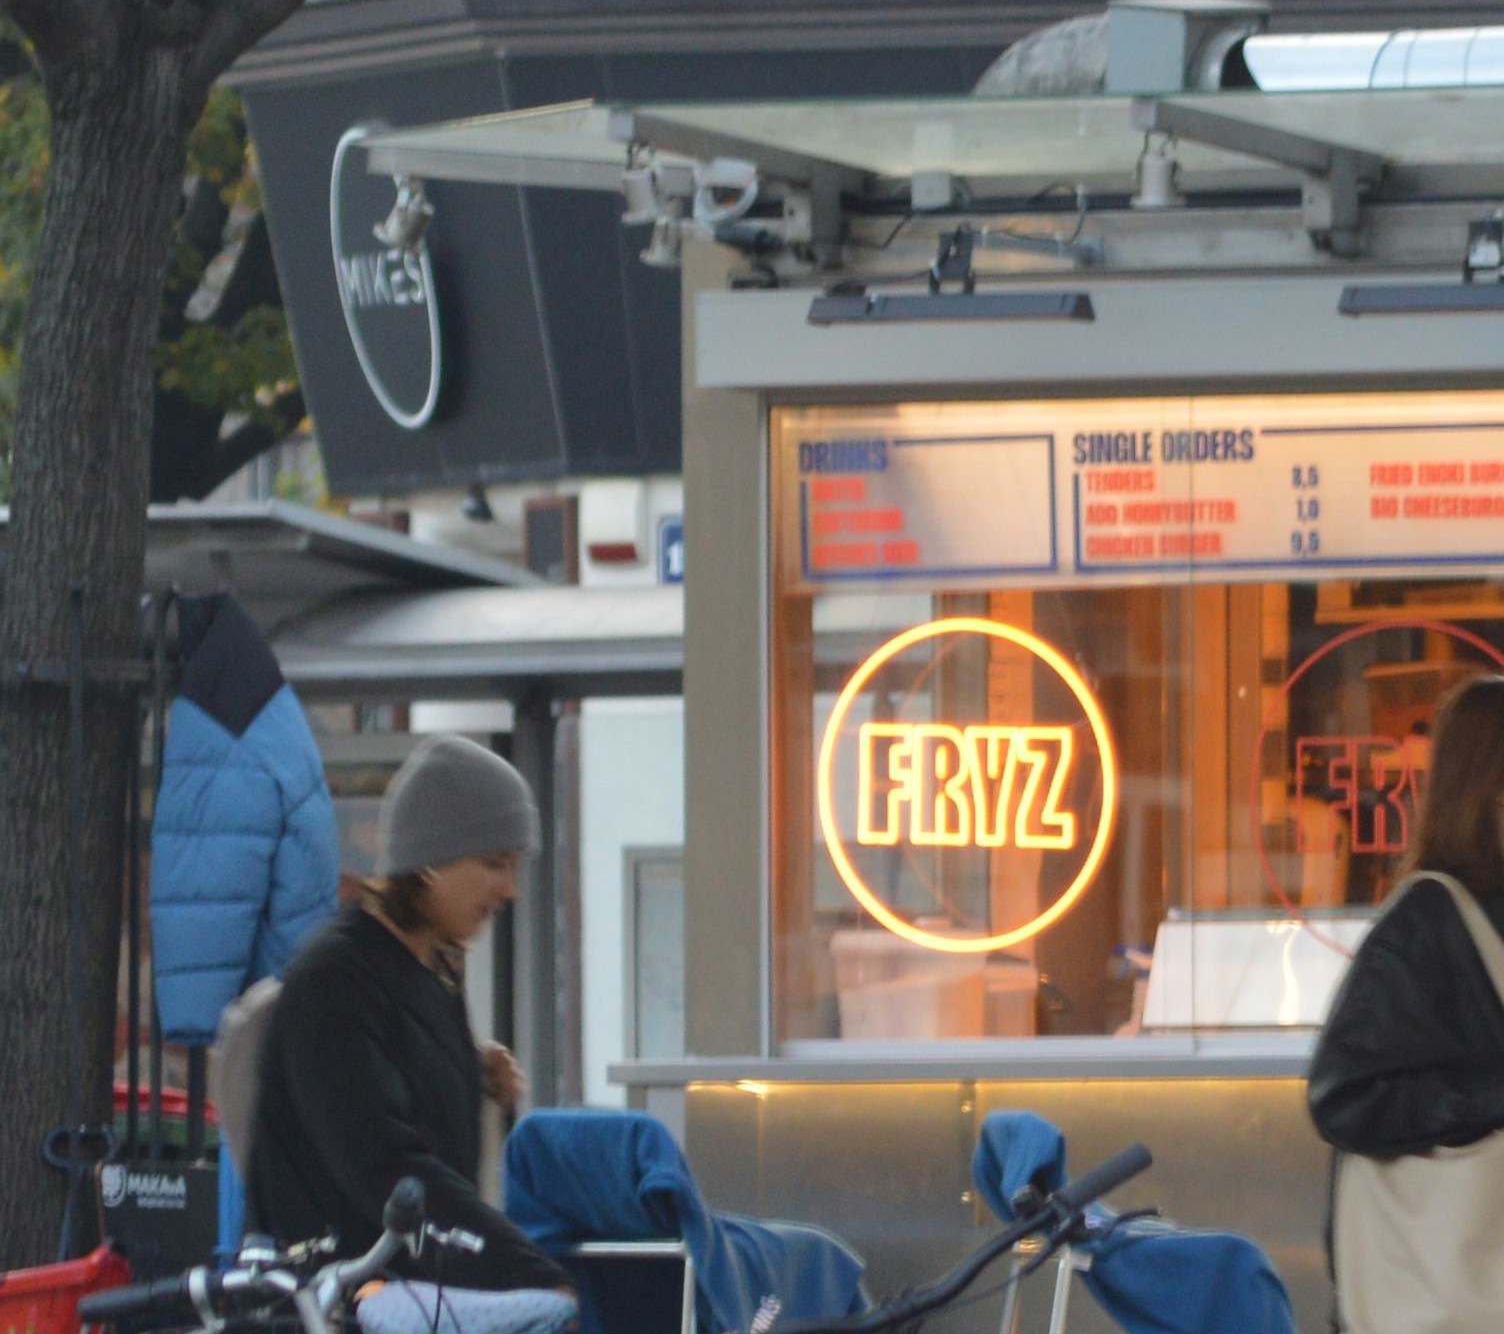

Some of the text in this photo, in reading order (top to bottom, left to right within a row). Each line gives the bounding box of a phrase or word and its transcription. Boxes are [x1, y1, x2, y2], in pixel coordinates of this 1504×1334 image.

[338, 249, 426, 307] MIKES
[798, 439, 887, 474] DRINKS
[1073, 429, 1254, 464] SINGLE ORDERS
[1086, 470, 1154, 492] TENDERS
[857, 722, 1076, 849] FRYZ
